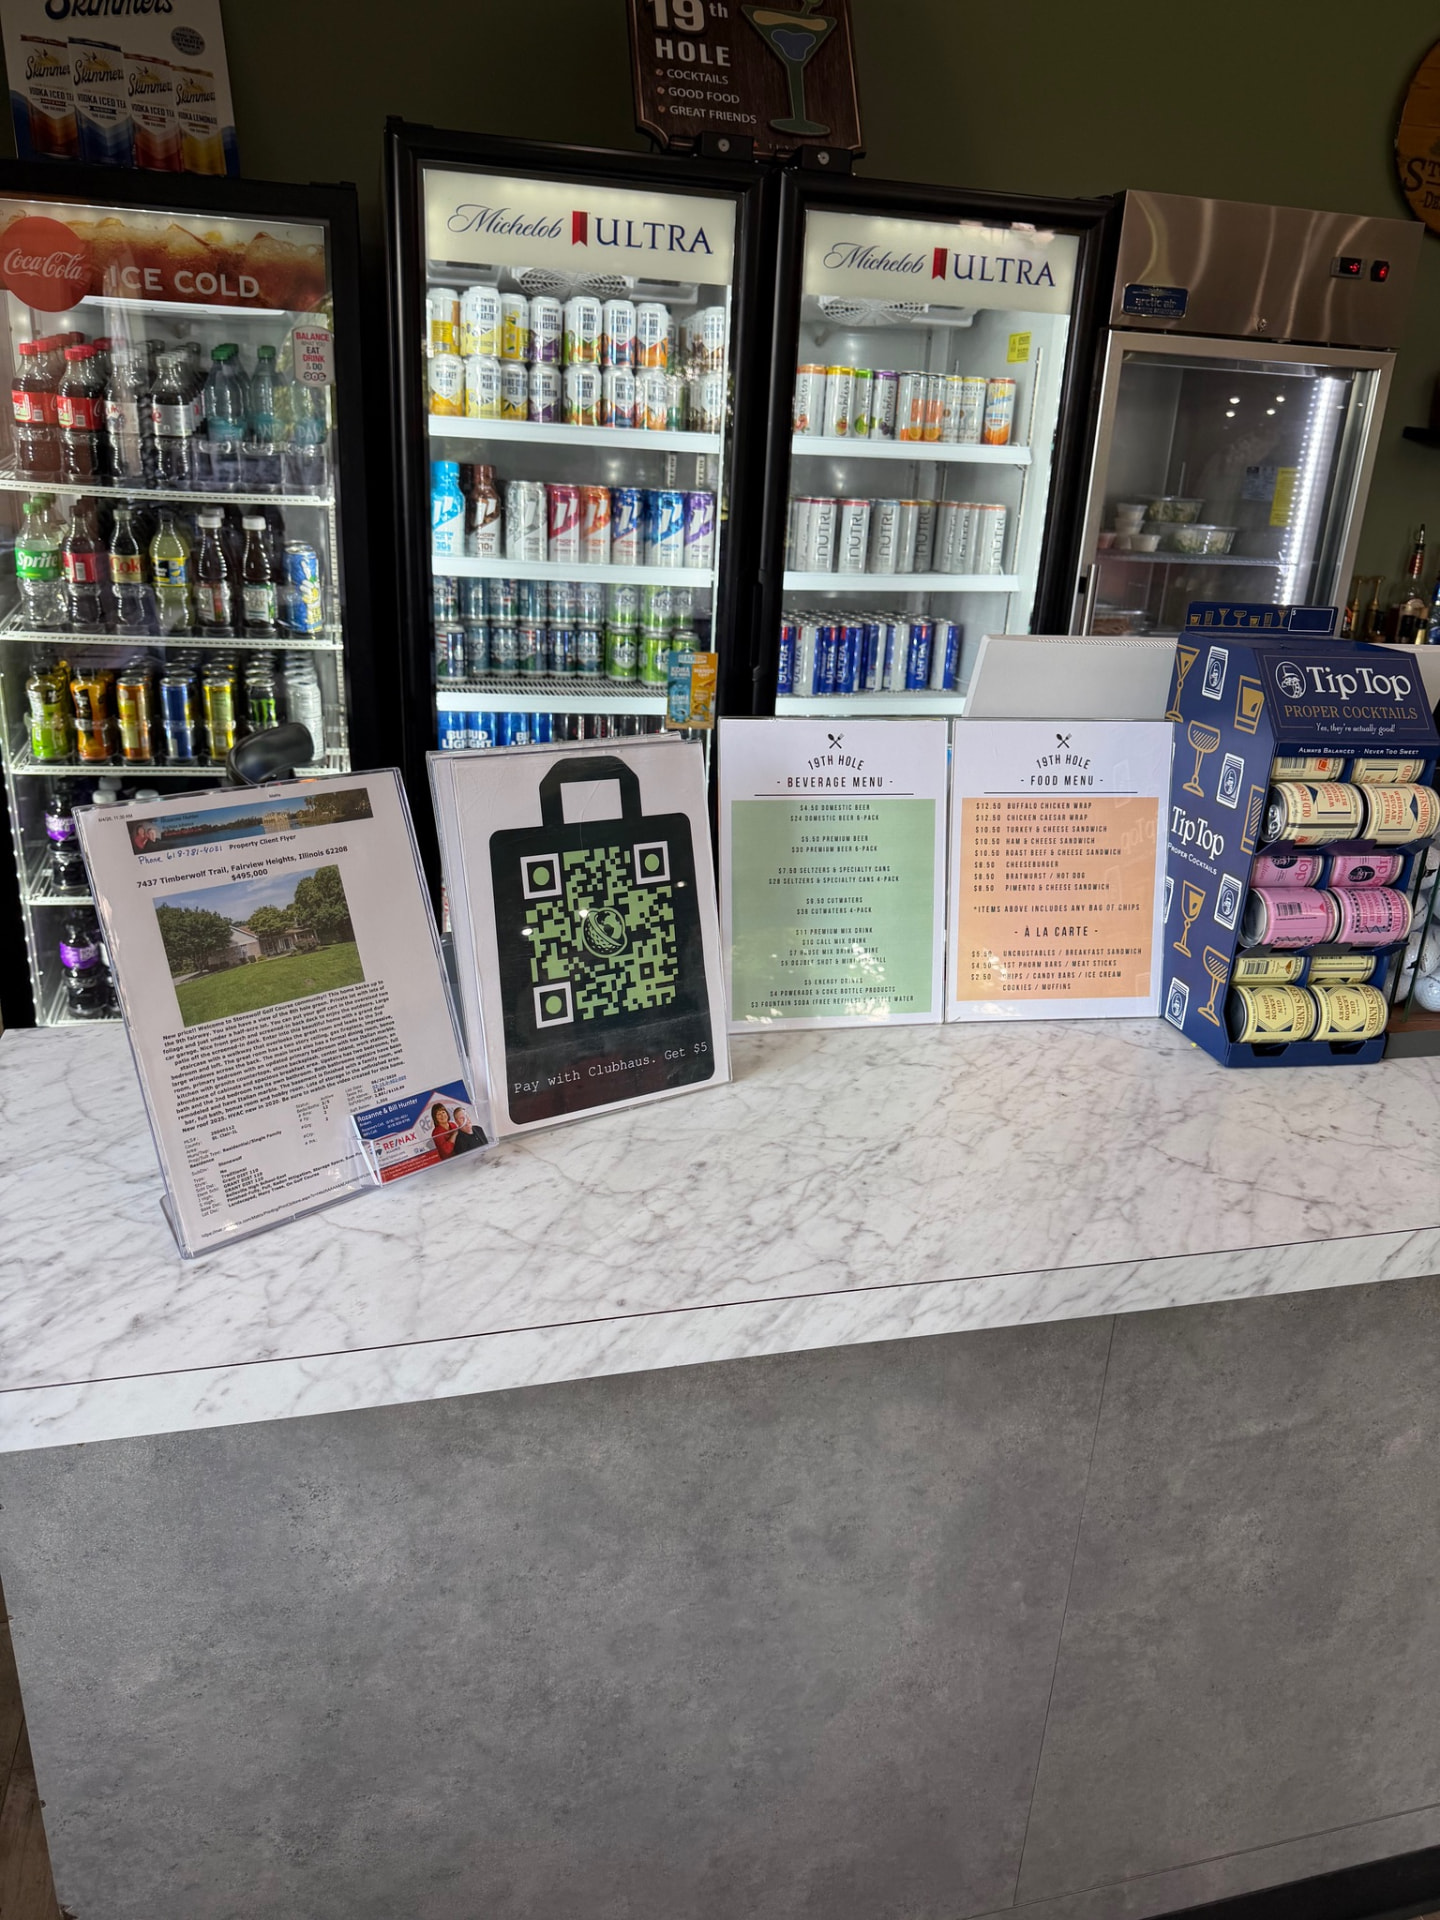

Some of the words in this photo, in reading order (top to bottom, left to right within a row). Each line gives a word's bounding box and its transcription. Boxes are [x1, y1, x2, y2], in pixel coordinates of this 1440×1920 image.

[655, 38, 731, 67] HOLE
[666, 68, 729, 85] COCKTAILS
[668, 87, 704, 100] GOOD
[706, 91, 740, 104] FOOD
[669, 105, 706, 118] GREAT
[709, 109, 757, 124] FRIENDS
[447, 203, 564, 239] Michelob
[595, 216, 713, 254] ULTRA
[3, 247, 83, 280] Coca-Cola
[822, 242, 927, 274] Michelob
[953, 253, 1056, 287] ULTRA
[109, 265, 163, 291] ICE
[173, 270, 260, 298] COLD
[295, 332, 330, 342] BALANCE
[306, 346, 320, 354] EAT
[17, 551, 58, 571] Sprite
[1284, 705, 1340, 718] PROPER
[1342, 706, 1418, 720] COCKTAILS
[1316, 722, 1330, 732] Yes,
[1330, 723, 1351, 735] they're
[1353, 724, 1377, 735] actually
[808, 755, 834, 770] 19TH
[839, 755, 864, 771] HOLE
[1036, 755, 1061, 769] 19TH
[1066, 754, 1091, 770] HOLE
[788, 777, 846, 788] BEVERAGE
[853, 777, 883, 787] MENU
[1031, 776, 1058, 786] FOOD
[1065, 776, 1094, 786] MENU
[1382, 791, 1390, 824] BITTERS
[1389, 794, 1397, 821] SUGAR
[1394, 790, 1402, 826] WHISKEY
[229, 840, 258, 851] Property
[260, 837, 279, 845] Client
[280, 834, 296, 843] Flyer
[136, 880, 158, 889] 7437
[160, 869, 206, 886] Timberwolf
[208, 865, 229, 877] Trail,
[231, 859, 264, 873] Fairview
[266, 854, 297, 869] Heights,
[299, 850, 324, 860] Illinois
[325, 846, 348, 854] 62208
[138, 856, 162, 865] Phone
[231, 868, 268, 882] $495,000
[1036, 927, 1048, 937] LA
[1054, 926, 1089, 937] CARTE
[1003, 949, 1056, 957] UNCRUSTABLES
[1262, 994, 1270, 1020] HONEY
[1268, 994, 1276, 1020] LEMON
[1336, 996, 1344, 1021] HONEY
[1342, 995, 1350, 1021] LEMON
[514, 1080, 539, 1094] Pay
[548, 1072, 581, 1086] with
[588, 1056, 656, 1077] Clubhaus.
[664, 1048, 686, 1061] Get
[694, 1042, 708, 1053] $5
[358, 1110, 384, 1122] Rozanne
